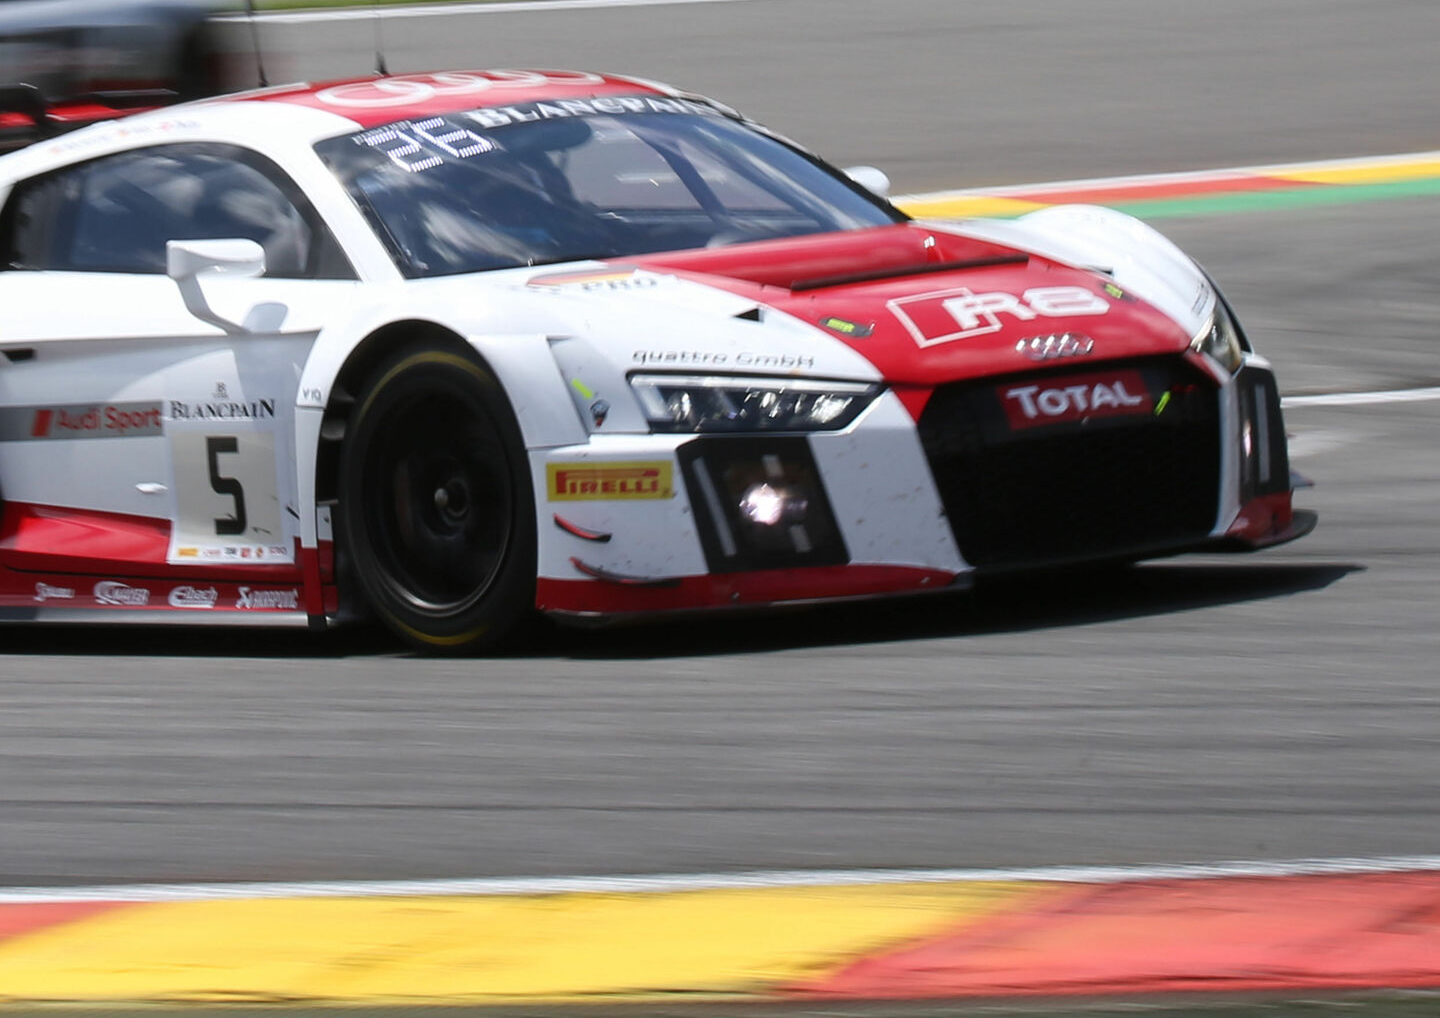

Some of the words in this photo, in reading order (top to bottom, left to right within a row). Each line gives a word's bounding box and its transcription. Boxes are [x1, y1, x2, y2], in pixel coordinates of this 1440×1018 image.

[942, 286, 1110, 330] R8
[632, 349, 728, 365] quattro
[736, 352, 814, 369] GmbH
[170, 398, 277, 420] BLANCPAIN
[1006, 381, 1144, 419] TOTAL
[57, 406, 100, 430] Audi
[104, 405, 162, 433] Sport
[205, 436, 247, 536] 5
[556, 468, 659, 495] PIRELLI
